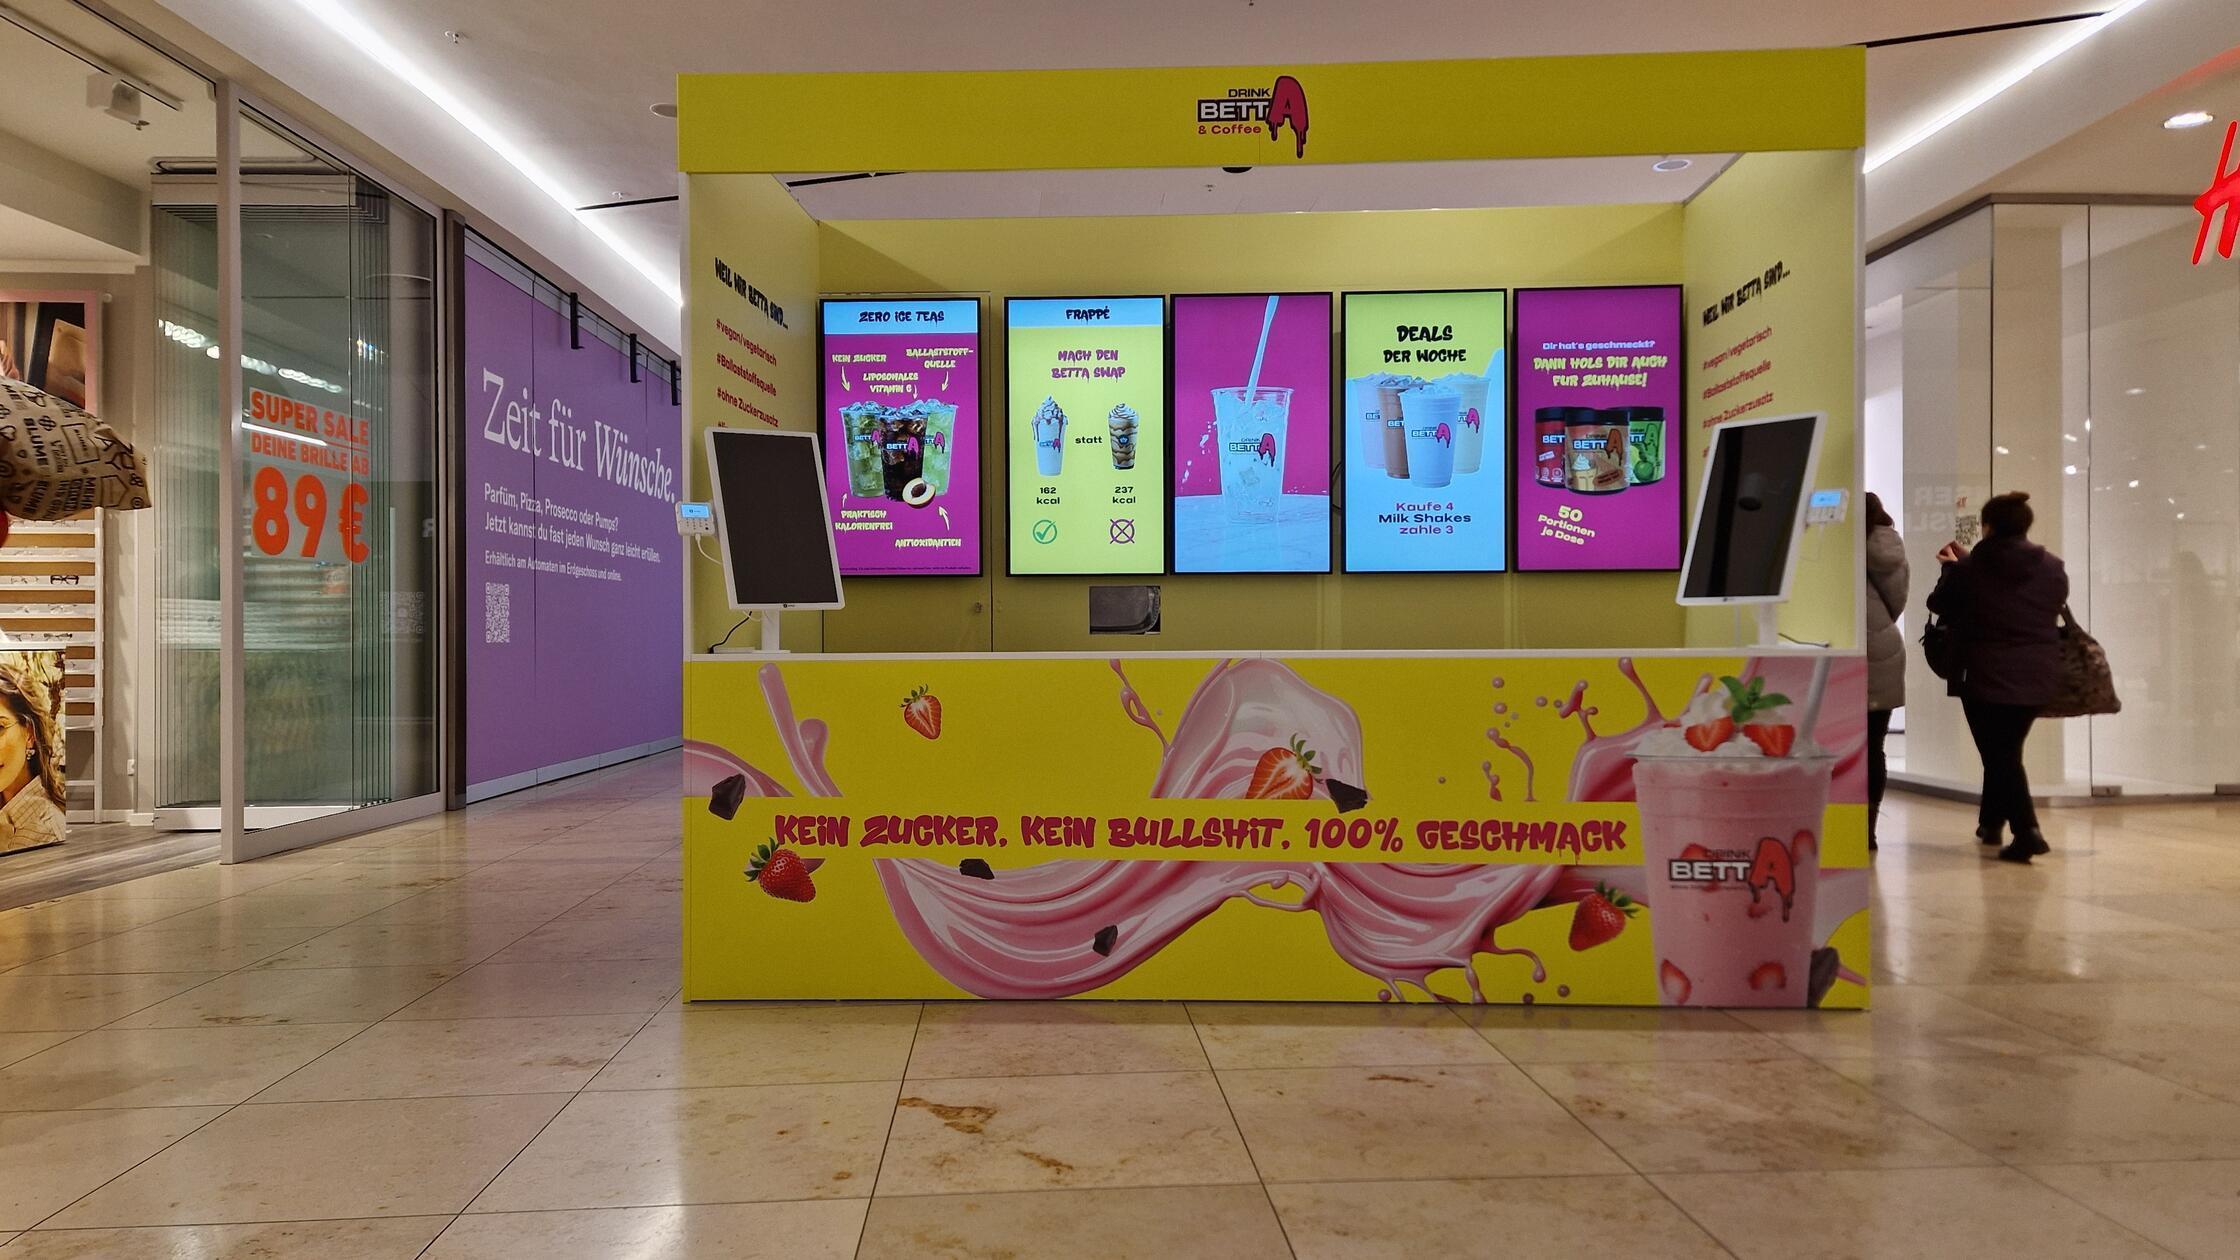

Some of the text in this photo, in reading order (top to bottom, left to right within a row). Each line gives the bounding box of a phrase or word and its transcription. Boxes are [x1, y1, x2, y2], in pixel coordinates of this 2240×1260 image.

[1228, 88, 1270, 98] DRINK
[1198, 76, 1309, 159] BETTA
[1198, 124, 1262, 134] & Coffee
[715, 257, 733, 288] WEIL
[734, 272, 747, 299] WIR
[749, 285, 769, 320] BETTA
[858, 311, 891, 323] ZERO
[916, 310, 945, 325] TEAS
[1066, 306, 1110, 323] FRAPPÉ
[1396, 325, 1453, 342] DEALS
[716, 318, 777, 367] #vegan/vegetarisch
[1542, 342, 1558, 350] Dir
[1585, 340, 1656, 351] geschmeckt?
[852, 354, 887, 363] ZUCKER
[924, 360, 956, 369] QUELLE
[1058, 350, 1119, 363] MACH DEN
[1383, 349, 1467, 363] DER WOCHE
[1533, 357, 1566, 371] DANN
[1570, 357, 1603, 369] HOLS
[1632, 355, 1668, 370] AUCH
[1051, 366, 1126, 380] BETTA SWAP
[1581, 372, 1648, 389] ZUHAUSE!
[251, 391, 369, 446] SUPER SALE
[483, 367, 675, 503] Zeit für Wünsche.
[1075, 436, 1103, 444] statt
[252, 432, 369, 476] DEINE BRILLE AB
[1114, 486, 1134, 494] 237
[484, 483, 619, 534] Parfüm, Pizza, Prosecco oder Pumps?
[1112, 496, 1136, 504] kcal
[1396, 502, 1454, 511] Kaufe 4
[252, 466, 369, 564] 89 €
[1378, 513, 1472, 523] Milk Shakes
[1558, 505, 1583, 522] 50
[1399, 525, 1454, 535] zahle 3
[1537, 514, 1596, 538] Portionen
[485, 512, 507, 533] Jetzt
[508, 517, 536, 539] kannst
[537, 524, 548, 541] du
[549, 527, 564, 545] fast
[565, 528, 584, 549] jeden
[586, 533, 610, 553] Wunsch
[611, 542, 625, 558] ganz
[625, 541, 641, 559] leicht
[1540, 526, 1585, 545] je Dose
[485, 550, 516, 568] Erhältlich
[517, 557, 527, 568] am
[527, 557, 559, 573] Automaten
[567, 562, 598, 579] Erdgeschoss
[1304, 817, 1403, 852] 100%
[1416, 819, 1628, 858] GESCHMACK
[1669, 837, 1795, 923] BETTA
